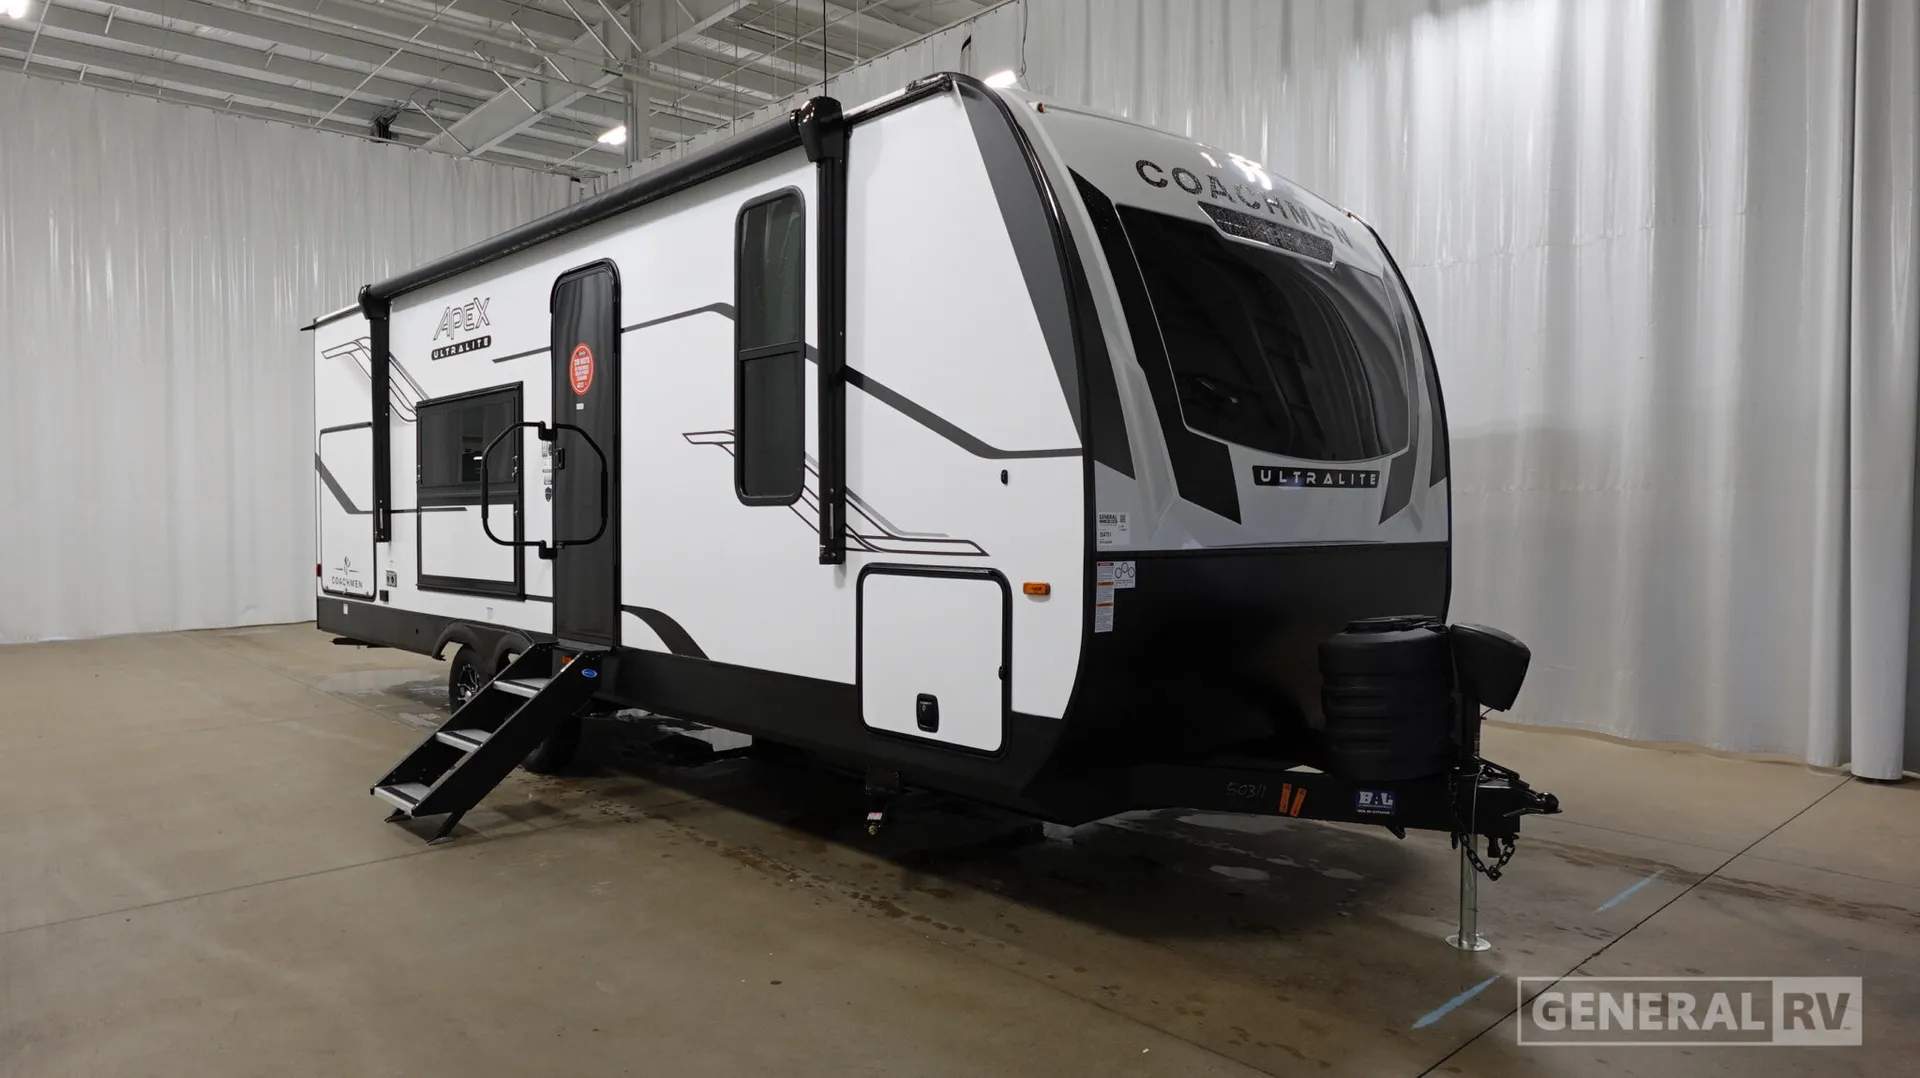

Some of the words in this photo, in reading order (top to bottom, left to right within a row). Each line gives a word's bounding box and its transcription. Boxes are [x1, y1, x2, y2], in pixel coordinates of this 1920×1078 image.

[1135, 159, 1354, 249] COACHMEN
[433, 297, 490, 341] APEX
[433, 336, 490, 359] ULTRALITE
[1260, 469, 1377, 486] ULTRALITE
[331, 576, 363, 589] COACHMEN
